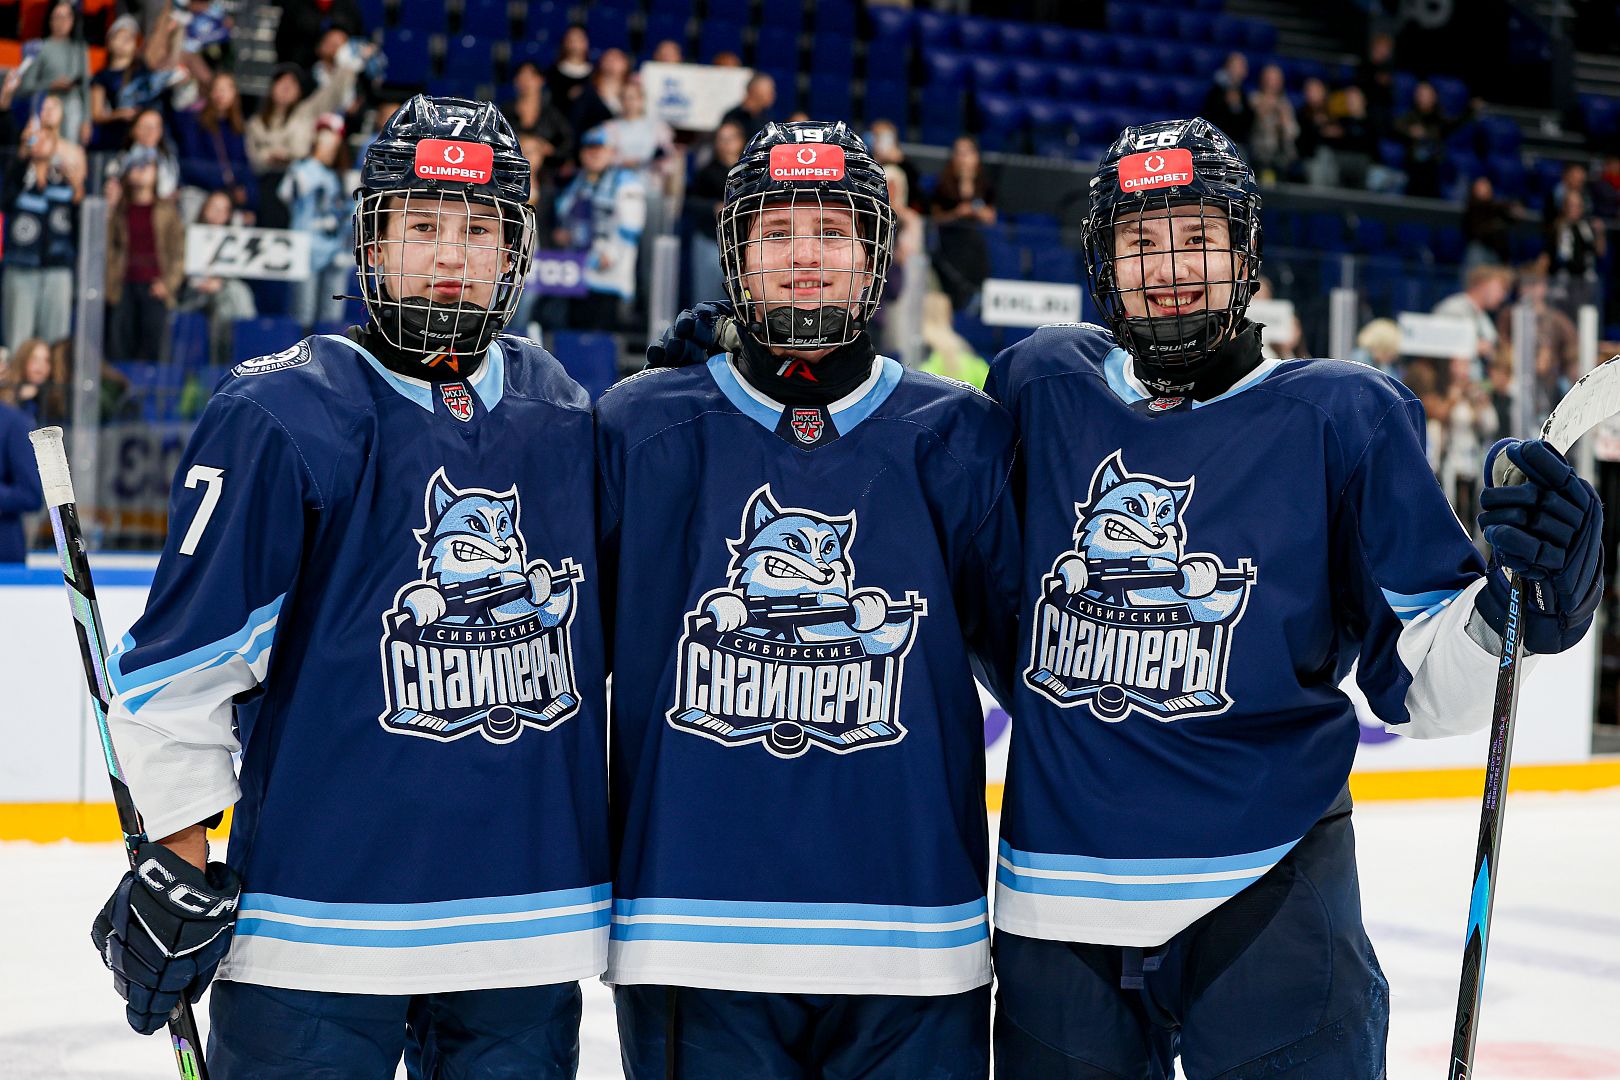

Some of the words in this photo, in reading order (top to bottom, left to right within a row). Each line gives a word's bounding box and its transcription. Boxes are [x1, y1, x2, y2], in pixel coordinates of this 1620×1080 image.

[446, 116, 467, 136] 7
[794, 128, 824, 142] 19
[1136, 131, 1180, 150] 26
[419, 165, 486, 179] OLIMPBET
[774, 168, 839, 177] OLIMPBET
[1124, 172, 1189, 188] OLIMPBET
[795, 414, 819, 422] МХЛ
[179, 464, 226, 556] 7
[1078, 600, 1179, 623] СИБИРСКИЕ
[436, 621, 536, 643] СИБИРСКИЕ
[734, 638, 853, 658] СИБИРСКИЕ
[138, 857, 242, 917] CCM
